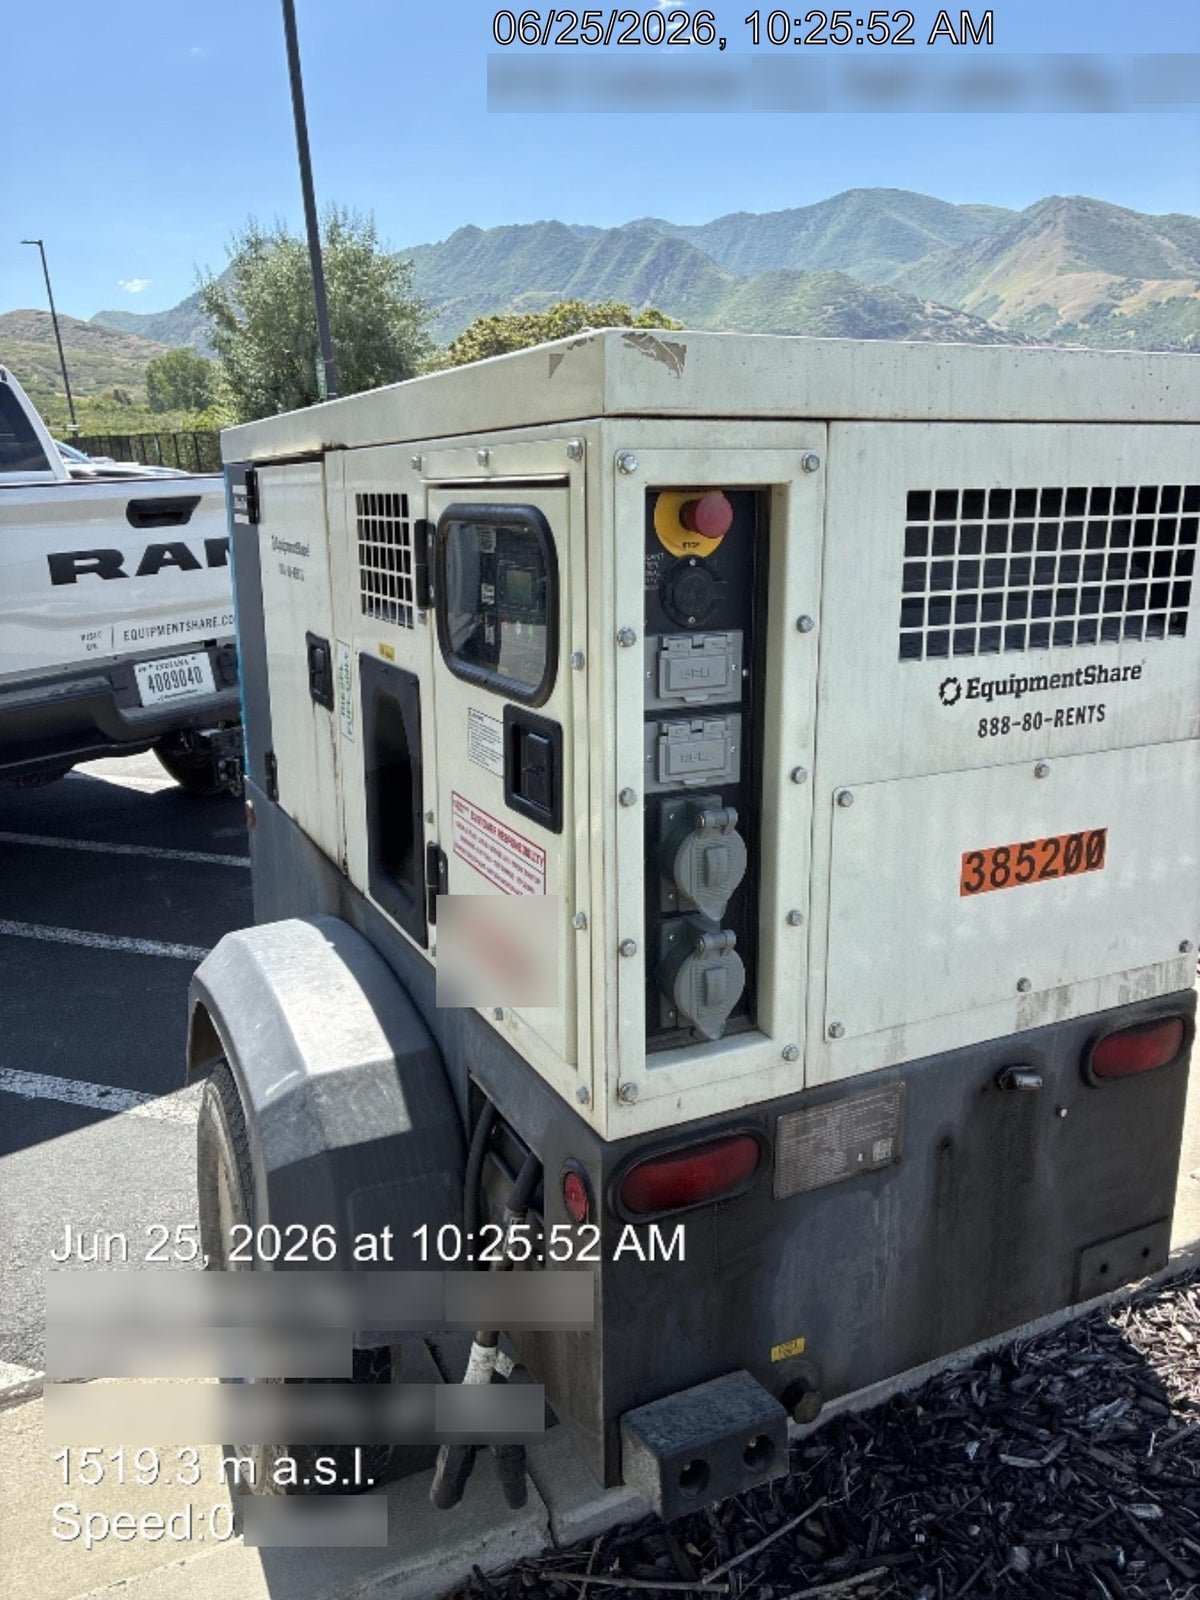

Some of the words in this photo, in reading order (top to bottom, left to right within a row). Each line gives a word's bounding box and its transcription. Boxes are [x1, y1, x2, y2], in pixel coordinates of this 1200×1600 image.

[965, 664, 1142, 702] EquipmentShare
[977, 703, 1106, 739] 888-80-RENTS
[963, 828, 1107, 893] 385200
